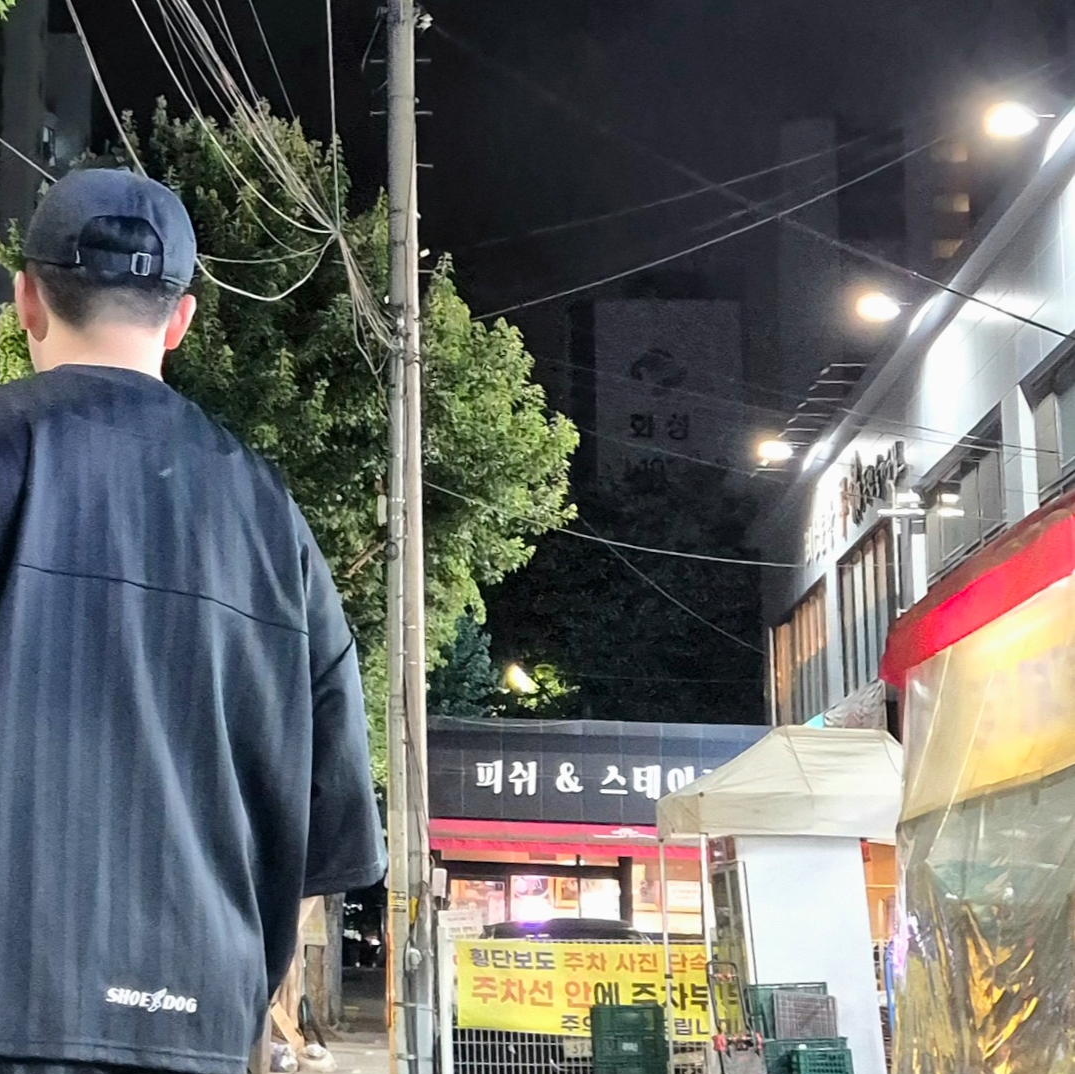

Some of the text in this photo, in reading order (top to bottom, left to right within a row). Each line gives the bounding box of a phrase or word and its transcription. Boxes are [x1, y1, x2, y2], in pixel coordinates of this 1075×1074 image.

[476, 760, 713, 800] 피쉬 & 스테이
[470, 948, 556, 970] 횡단보도
[564, 952, 608, 972] 주차
[615, 953, 658, 973] 사진
[472, 976, 554, 1007] 주차선
[565, 981, 620, 1009] 안에
